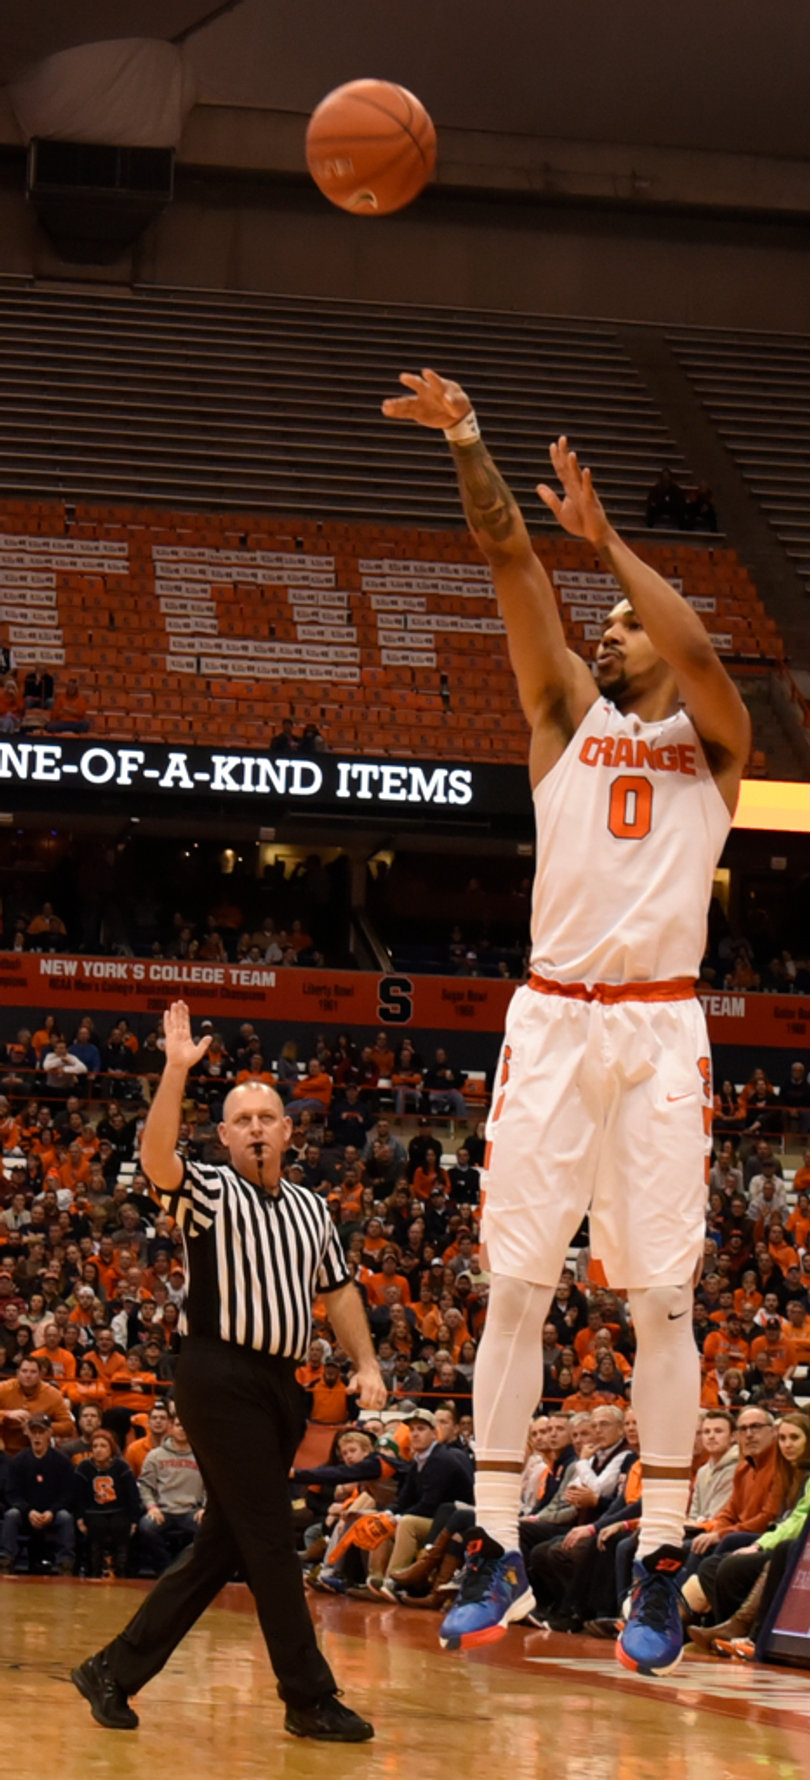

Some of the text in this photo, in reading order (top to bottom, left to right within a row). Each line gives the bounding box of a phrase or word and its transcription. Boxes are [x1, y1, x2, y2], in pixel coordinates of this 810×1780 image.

[579, 736, 697, 776] ORANGE
[336, 763, 473, 805] ITEMS
[607, 775, 654, 840] 0
[39, 958, 78, 977] NEW
[82, 961, 145, 980] YORK'S
[149, 965, 225, 984] COLLEGE
[229, 969, 276, 987] TEAM
[376, 975, 415, 1025] S
[700, 995, 746, 1017] TEAM
